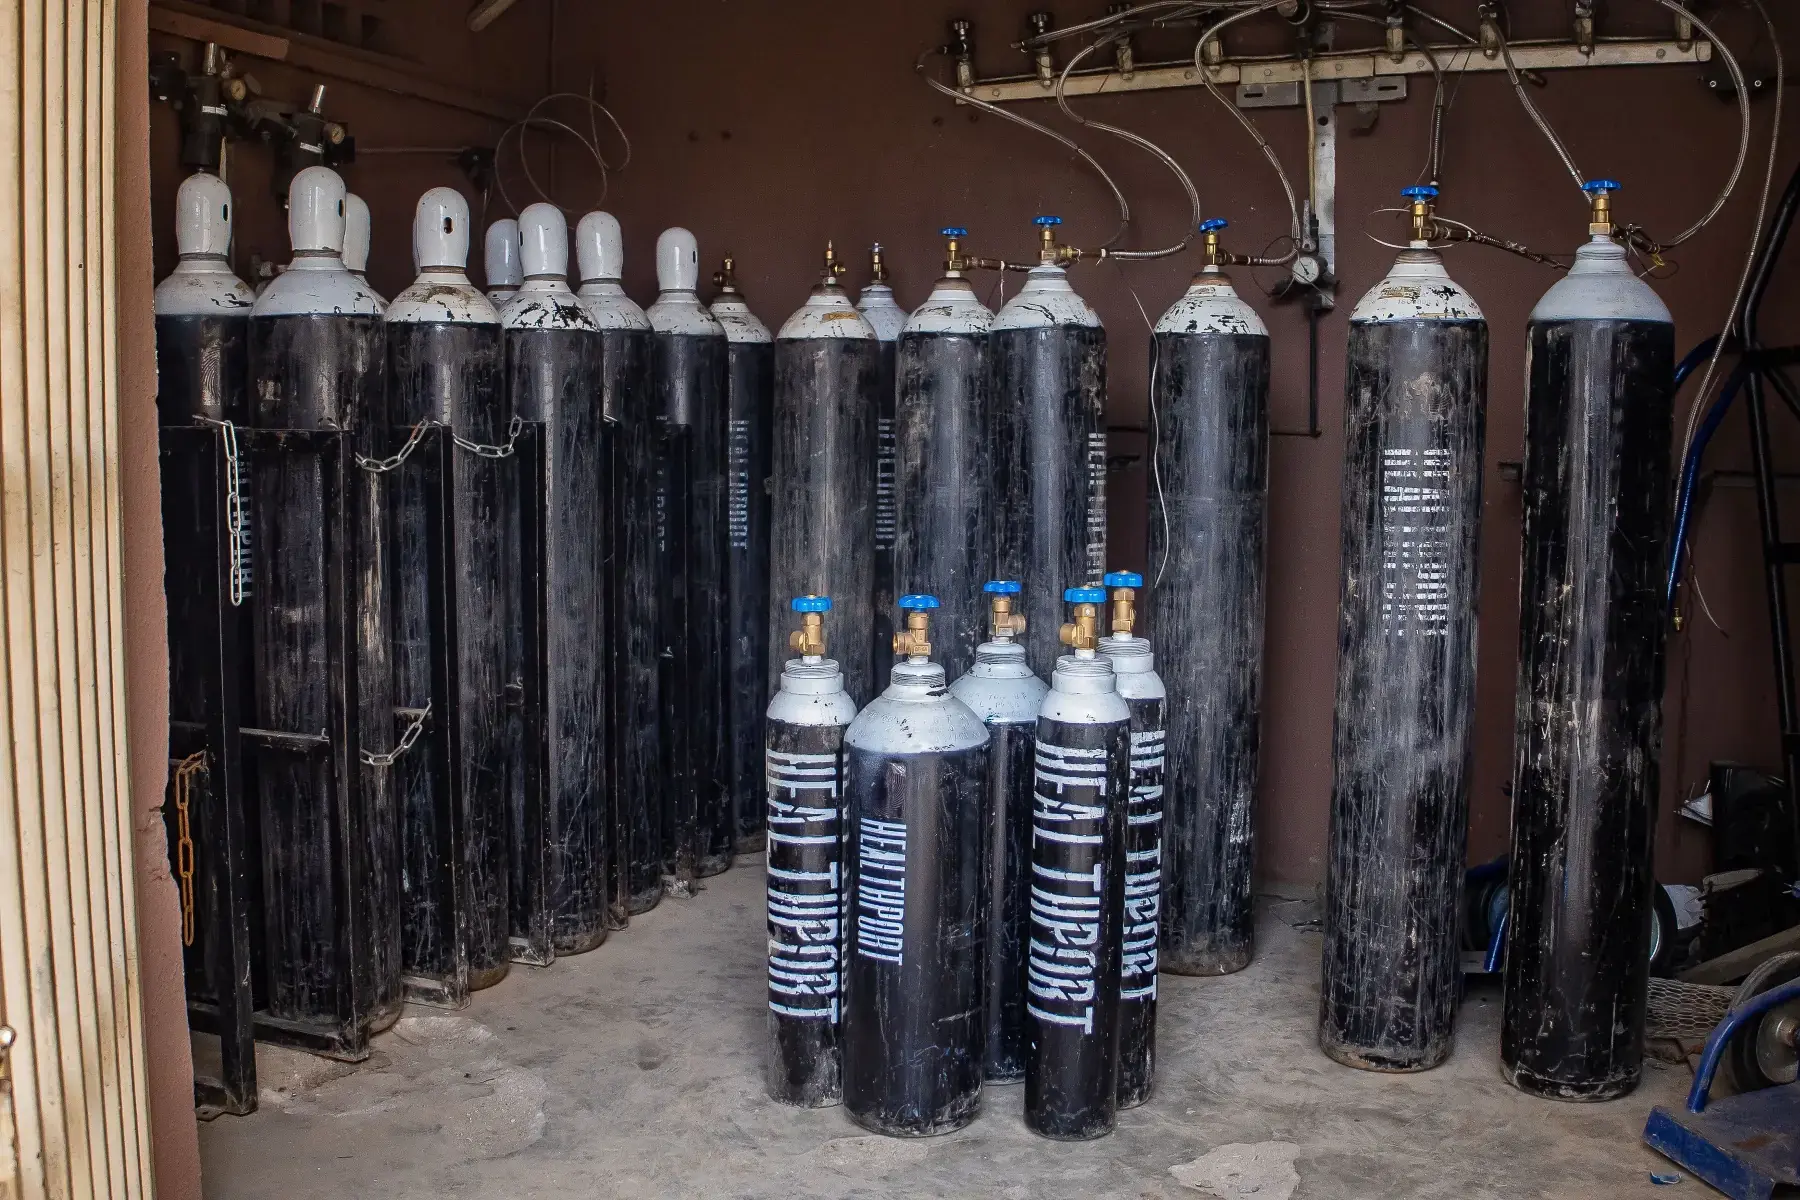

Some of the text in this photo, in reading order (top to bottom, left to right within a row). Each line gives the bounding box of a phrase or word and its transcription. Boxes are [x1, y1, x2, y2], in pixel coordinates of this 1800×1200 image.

[767, 749, 838, 1024] HEALTHPORT
[858, 817, 907, 966] HEALTHPORT
[1027, 738, 1107, 1034] HEALTHPORT
